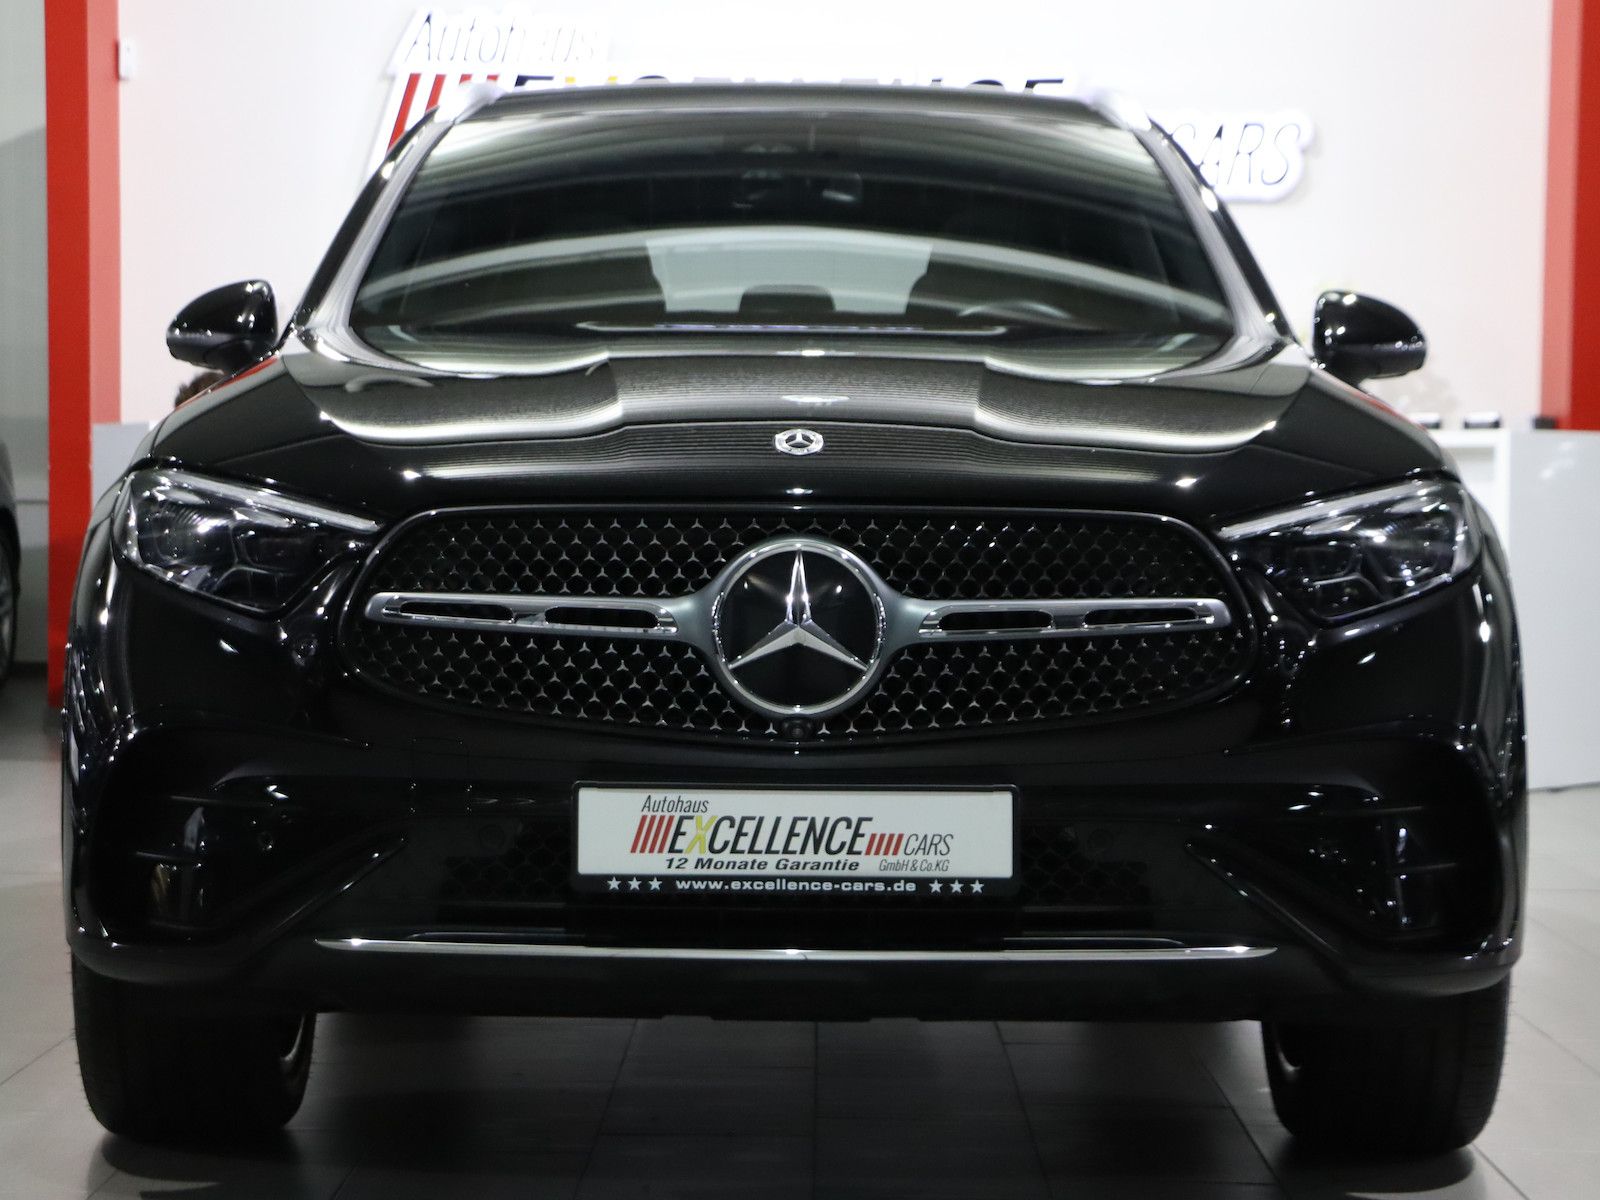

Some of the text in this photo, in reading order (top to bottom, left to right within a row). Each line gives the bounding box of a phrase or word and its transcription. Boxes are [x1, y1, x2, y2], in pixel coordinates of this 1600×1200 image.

[641, 794, 709, 813] Autohaus
[668, 815, 954, 856] EXCELLENCE CARS
[666, 857, 859, 871] 12 Monate Garantie
[879, 859, 908, 872] GmbH
[910, 860, 917, 872] &
[675, 878, 917, 892] www.excellence-cars.de
